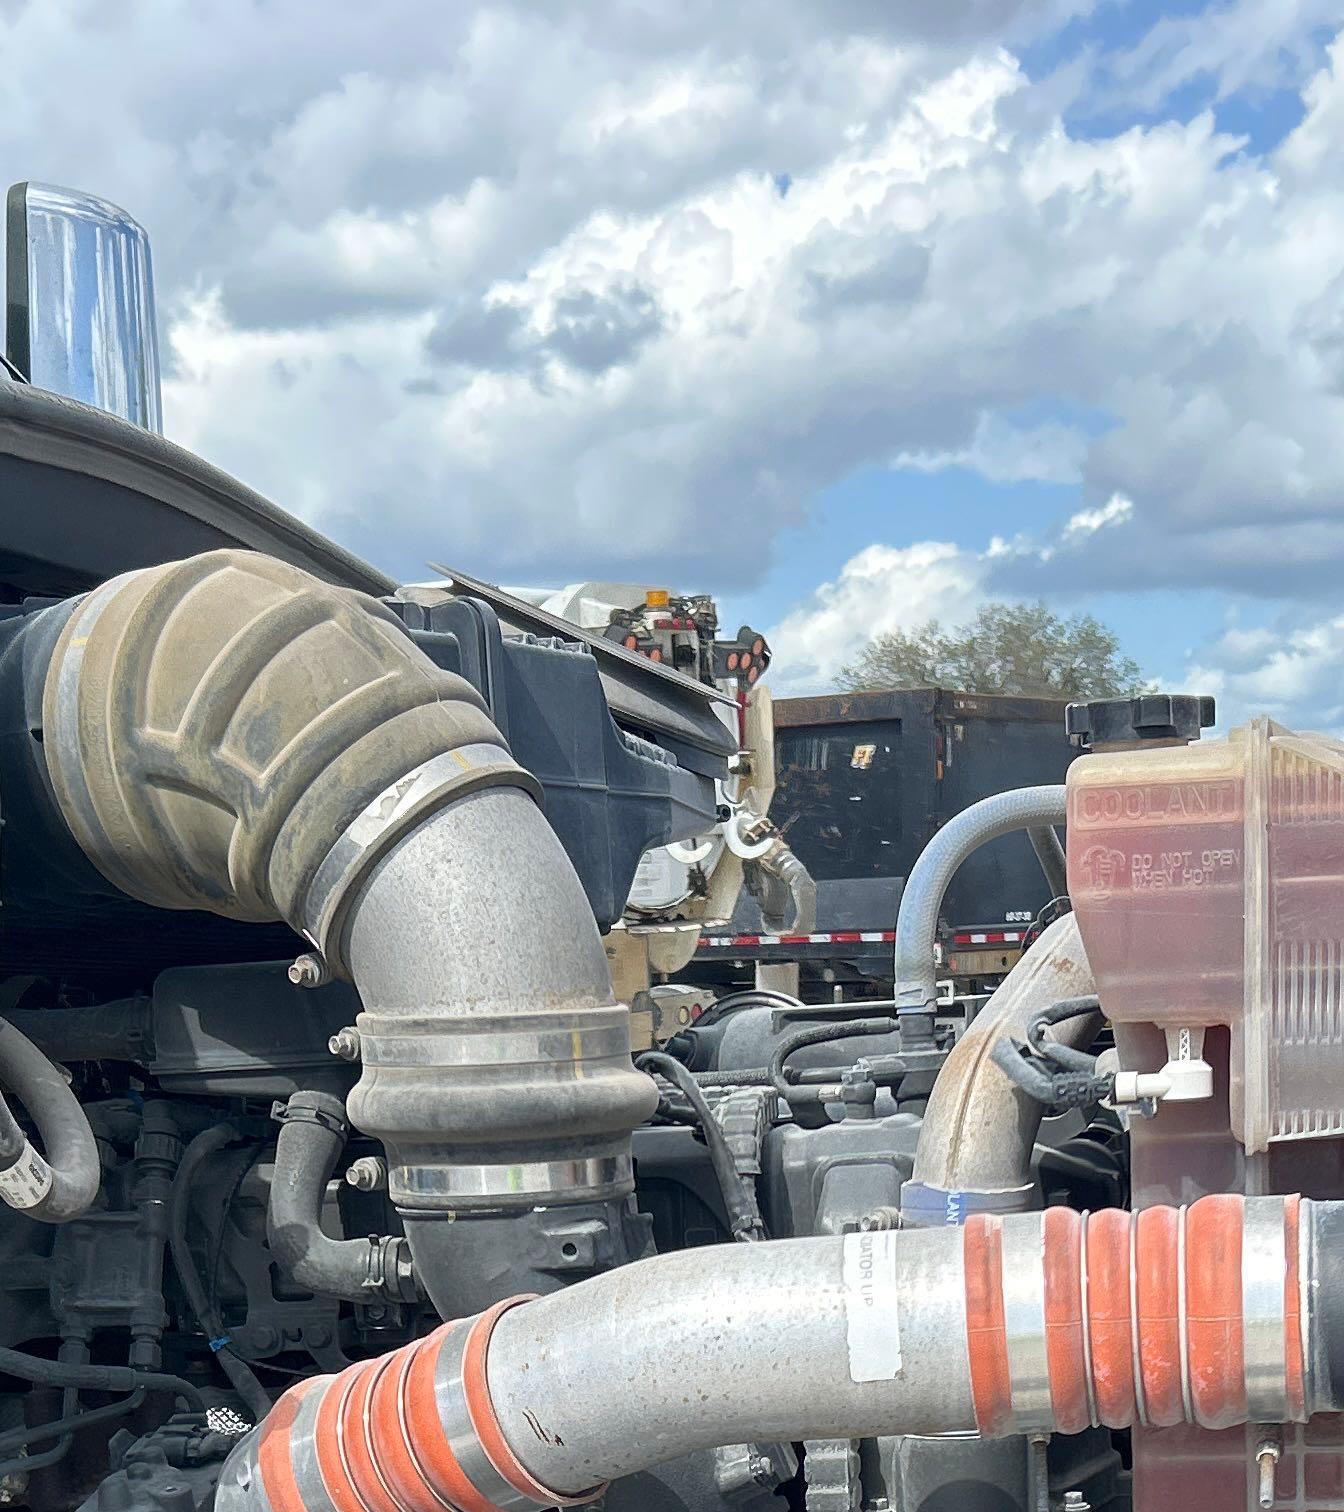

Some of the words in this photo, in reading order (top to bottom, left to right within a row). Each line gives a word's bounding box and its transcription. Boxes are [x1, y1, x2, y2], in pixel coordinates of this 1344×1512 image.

[1080, 784, 1229, 822] COOLANT
[1132, 853, 1152, 869] DO
[1160, 851, 1193, 868] NOT
[1202, 848, 1242, 867] OPEN
[1182, 867, 1216, 886] HOT
